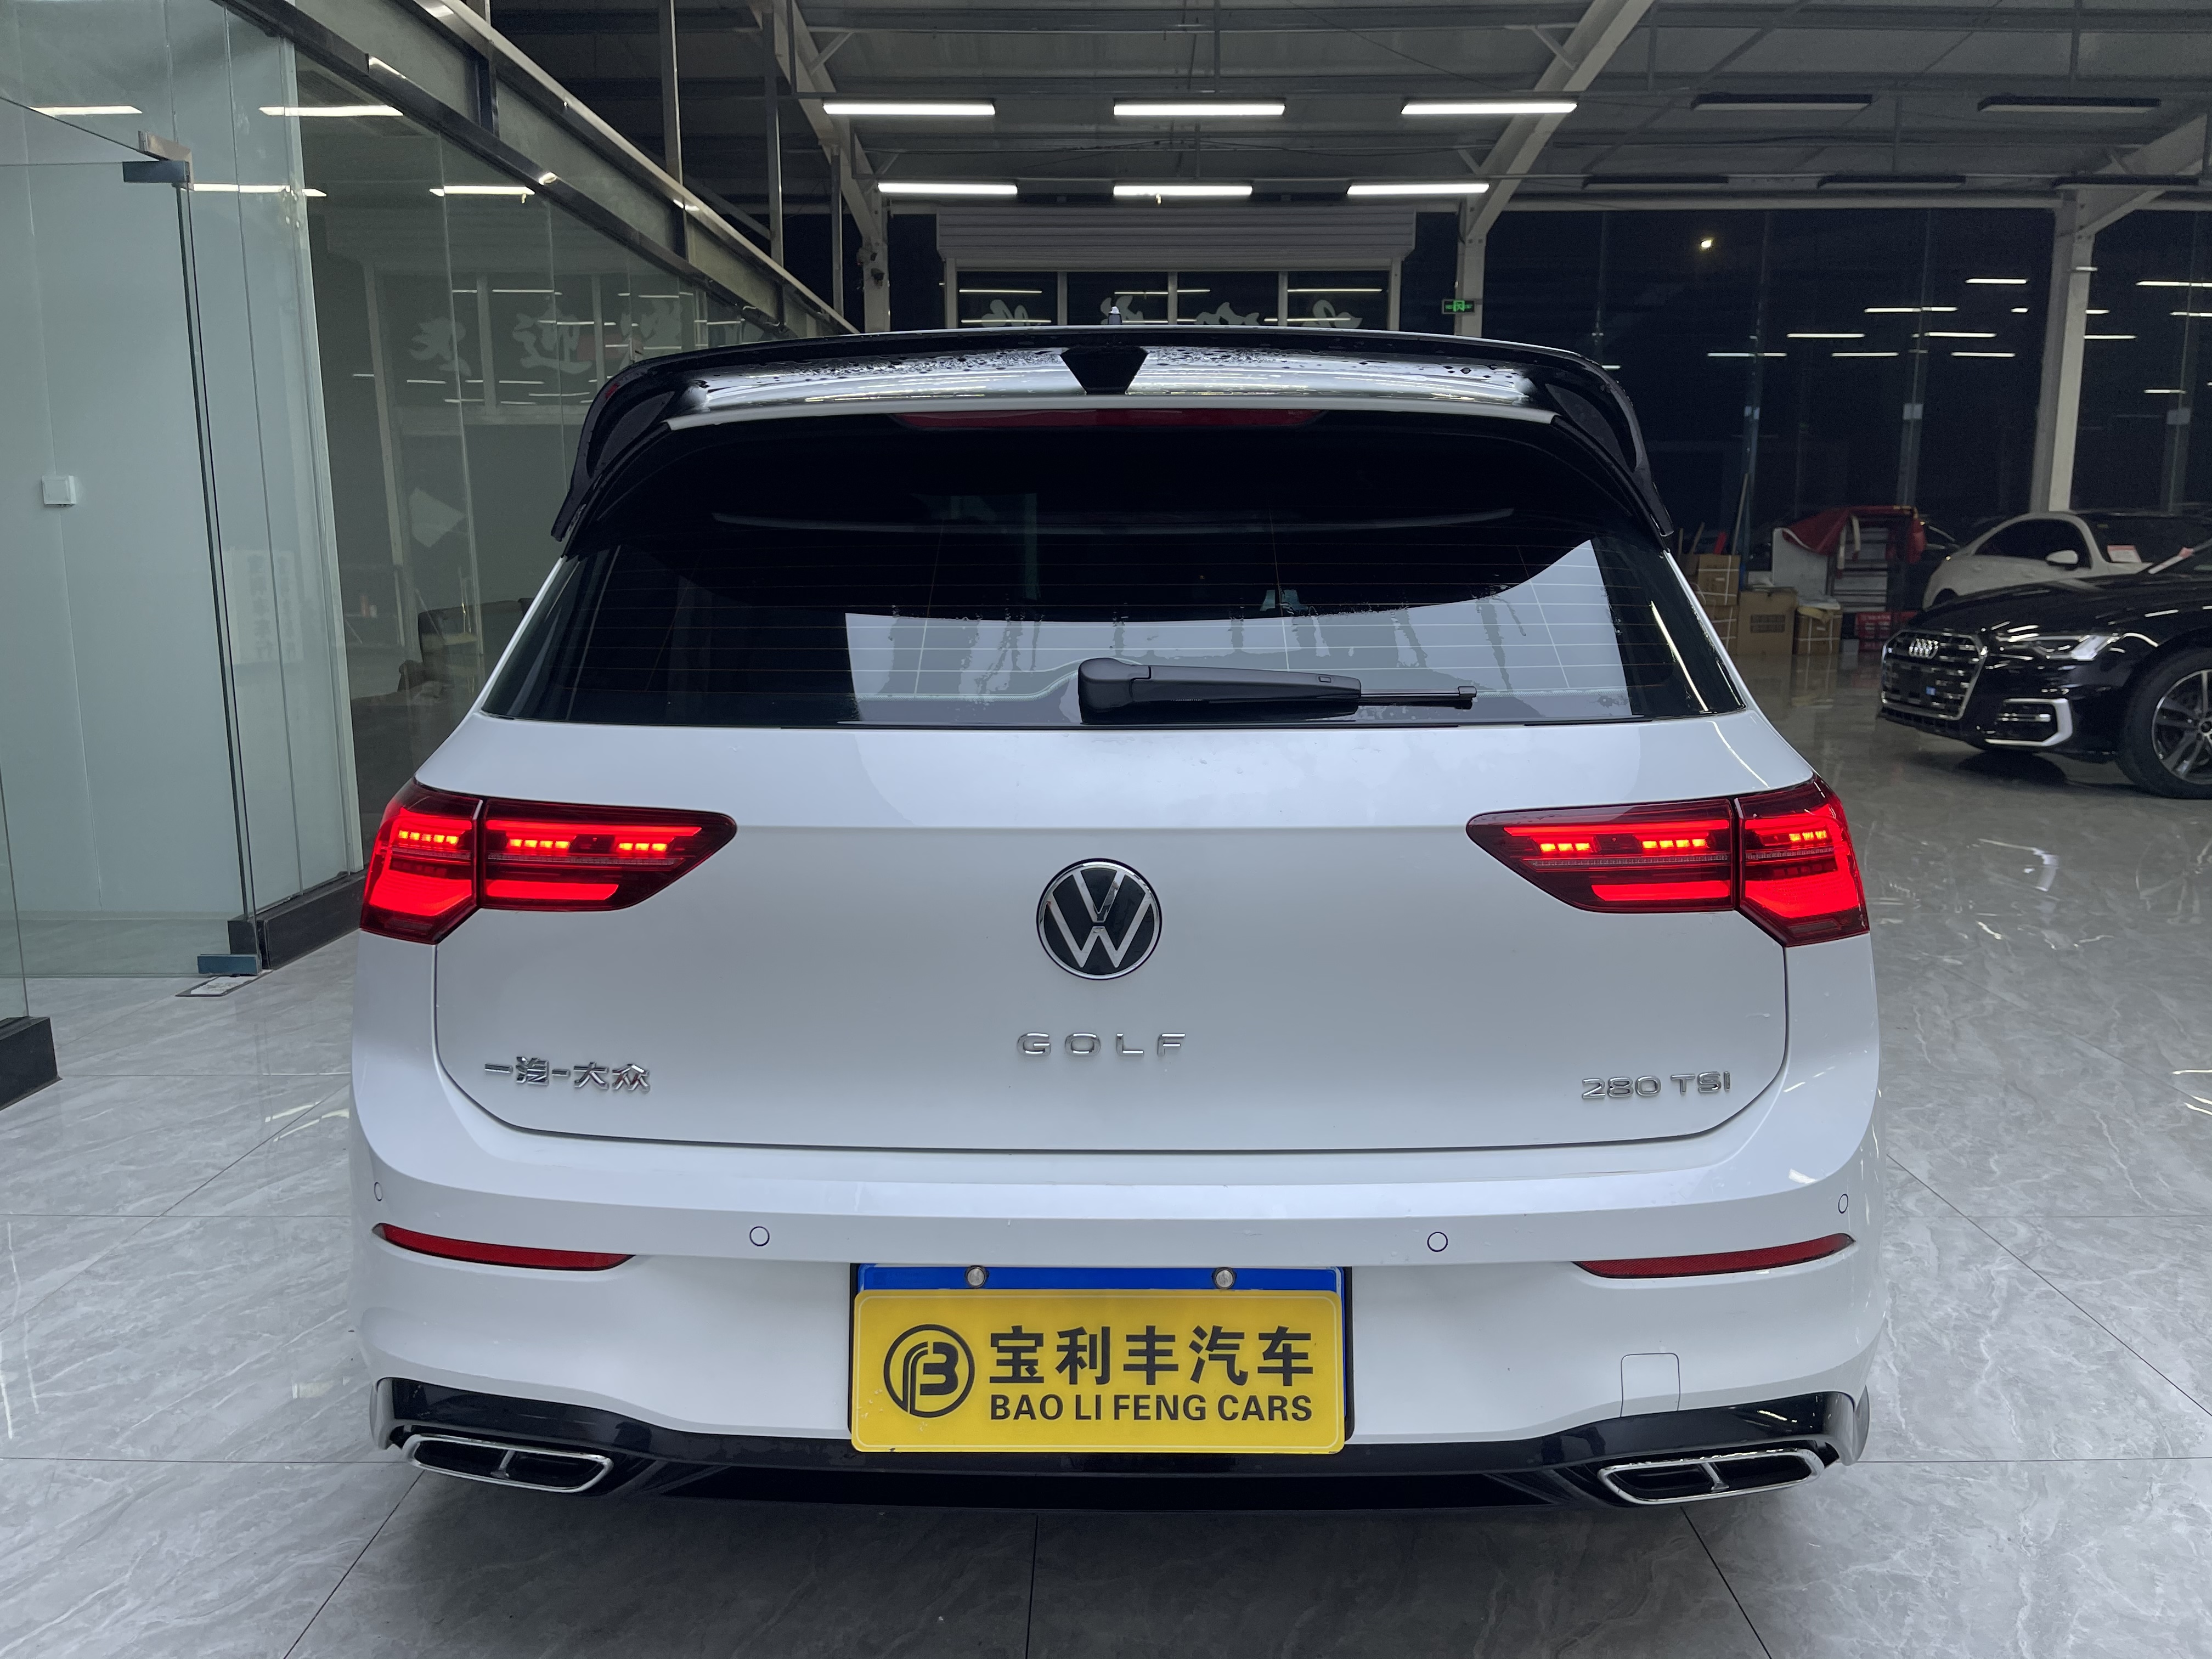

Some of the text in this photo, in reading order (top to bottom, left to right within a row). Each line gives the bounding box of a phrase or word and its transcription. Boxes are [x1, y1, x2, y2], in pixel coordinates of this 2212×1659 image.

[1017, 1032, 1186, 1057] GOLF
[484, 1056, 650, 1091] 一汽-大众
[1582, 1070, 1731, 1098] 280 TSI
[989, 1325, 1314, 1386] 宝利丰汽车
[990, 1393, 1312, 1421] BAO LI FENG CARS
